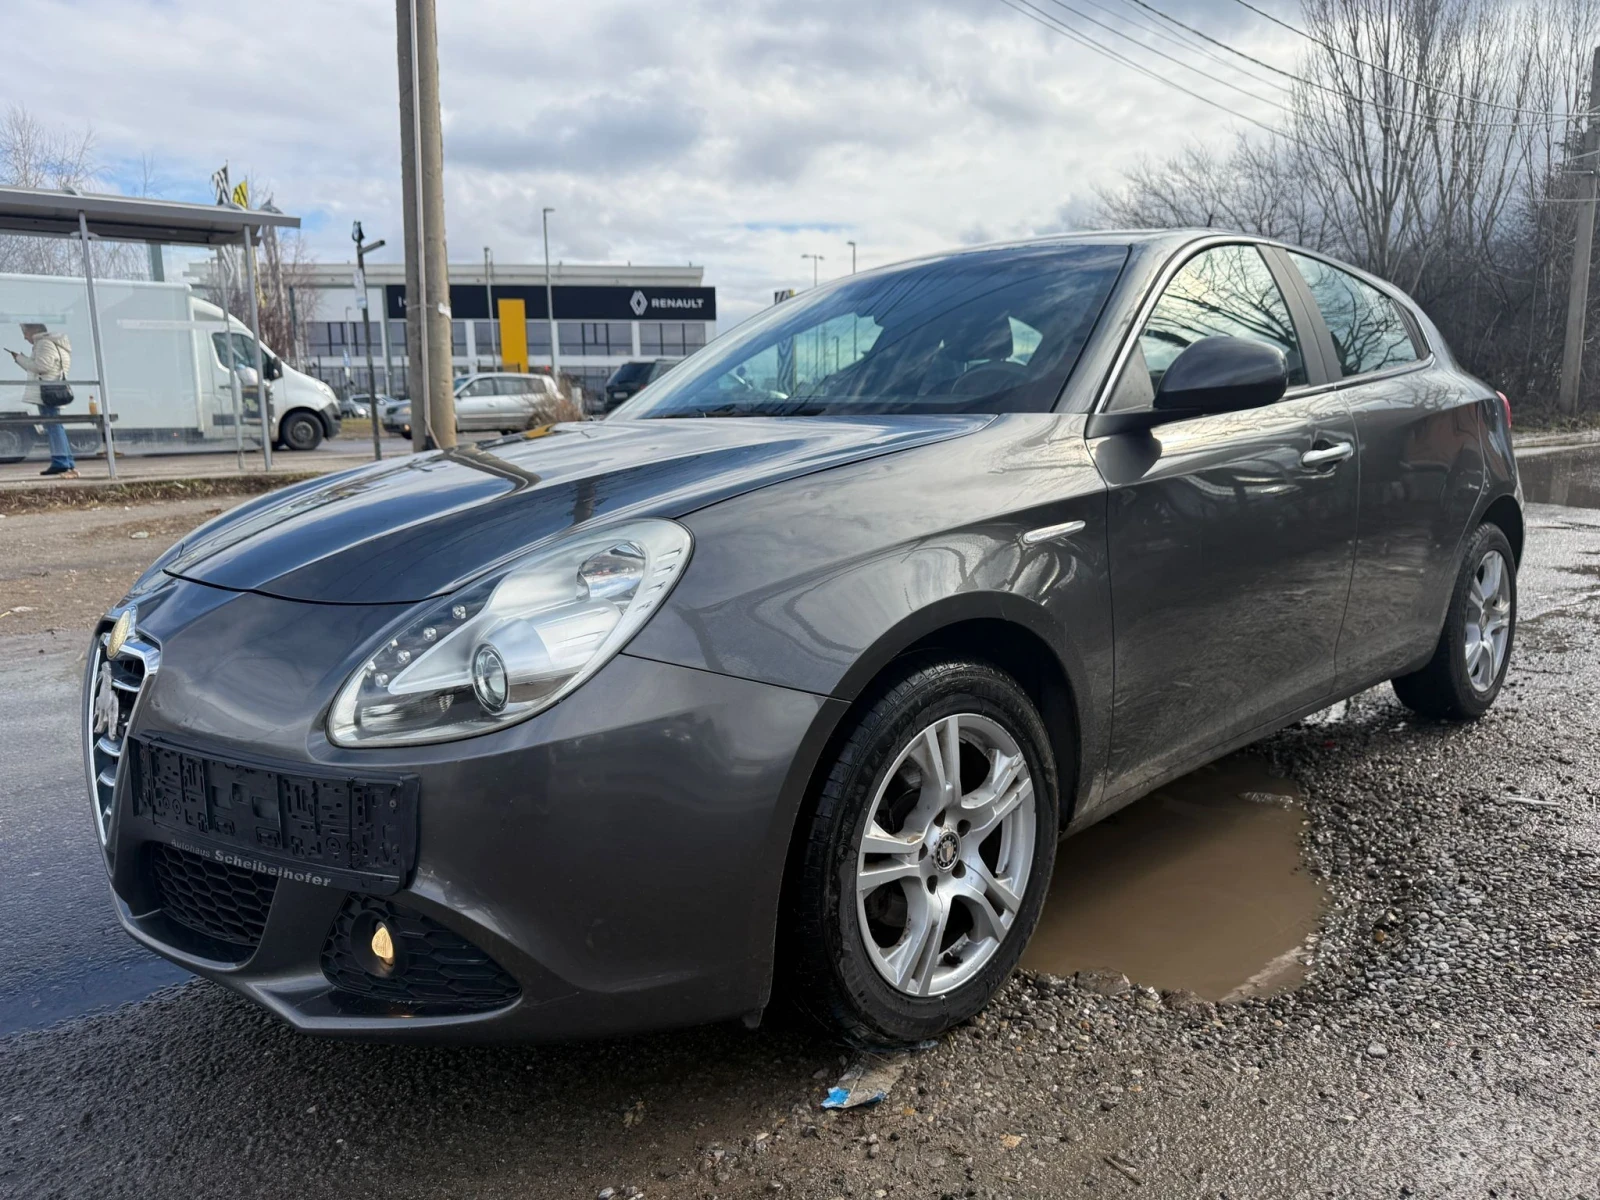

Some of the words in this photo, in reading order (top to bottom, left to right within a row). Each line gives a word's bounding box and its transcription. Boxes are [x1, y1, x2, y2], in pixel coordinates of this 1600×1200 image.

[651, 298, 704, 308] RENAULT
[171, 838, 210, 857] Autohaus
[214, 850, 331, 886] Scheibelhofer
